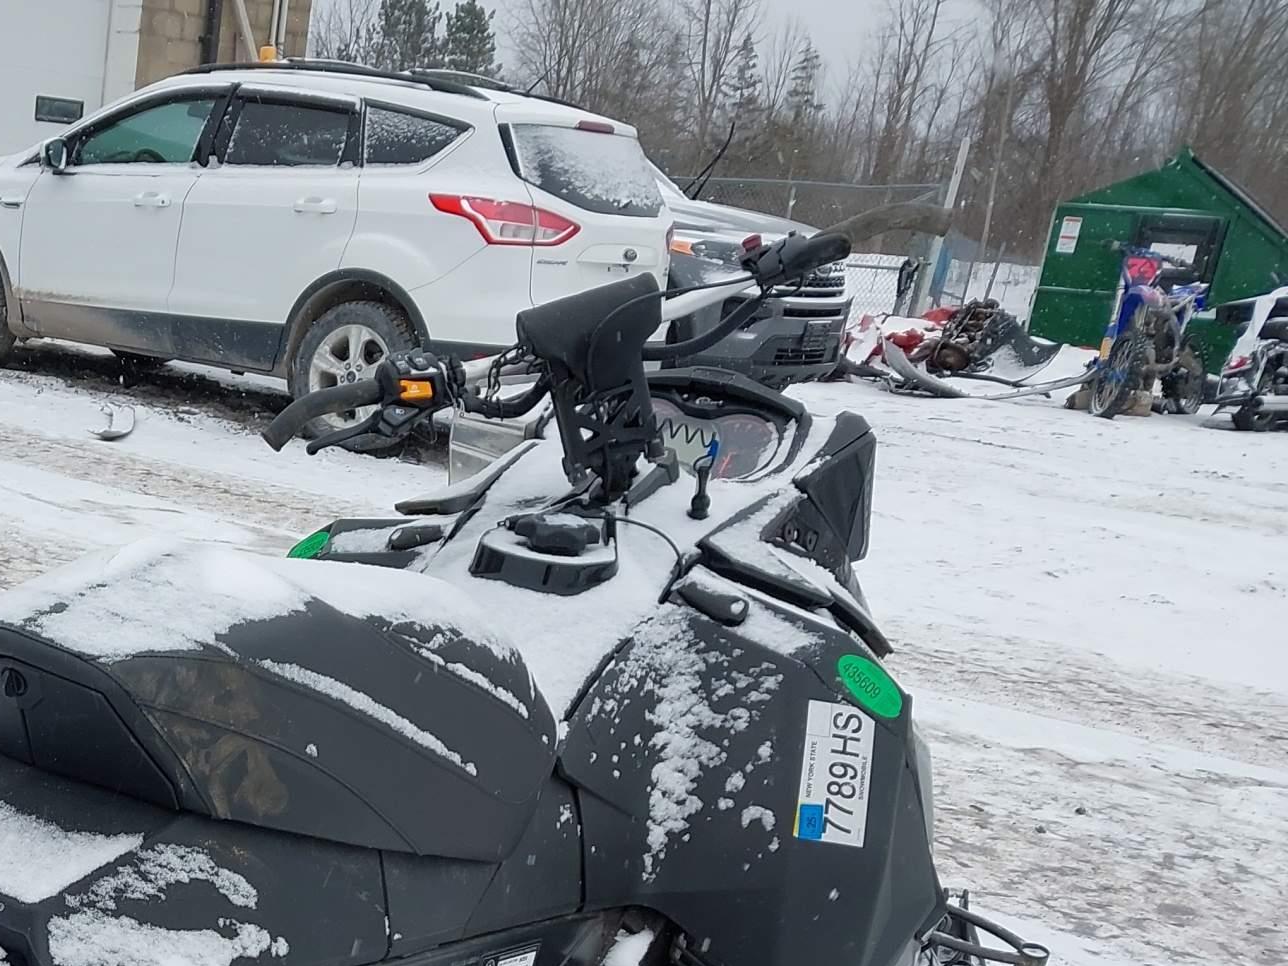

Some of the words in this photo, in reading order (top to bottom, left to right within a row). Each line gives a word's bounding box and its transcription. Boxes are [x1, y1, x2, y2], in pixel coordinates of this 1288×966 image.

[843, 662, 881, 699] 435609
[829, 711, 863, 759] HS
[808, 740, 819, 762] STATE
[806, 762, 817, 781] YORK
[805, 781, 815, 799] NEW
[823, 760, 859, 835] 7789
